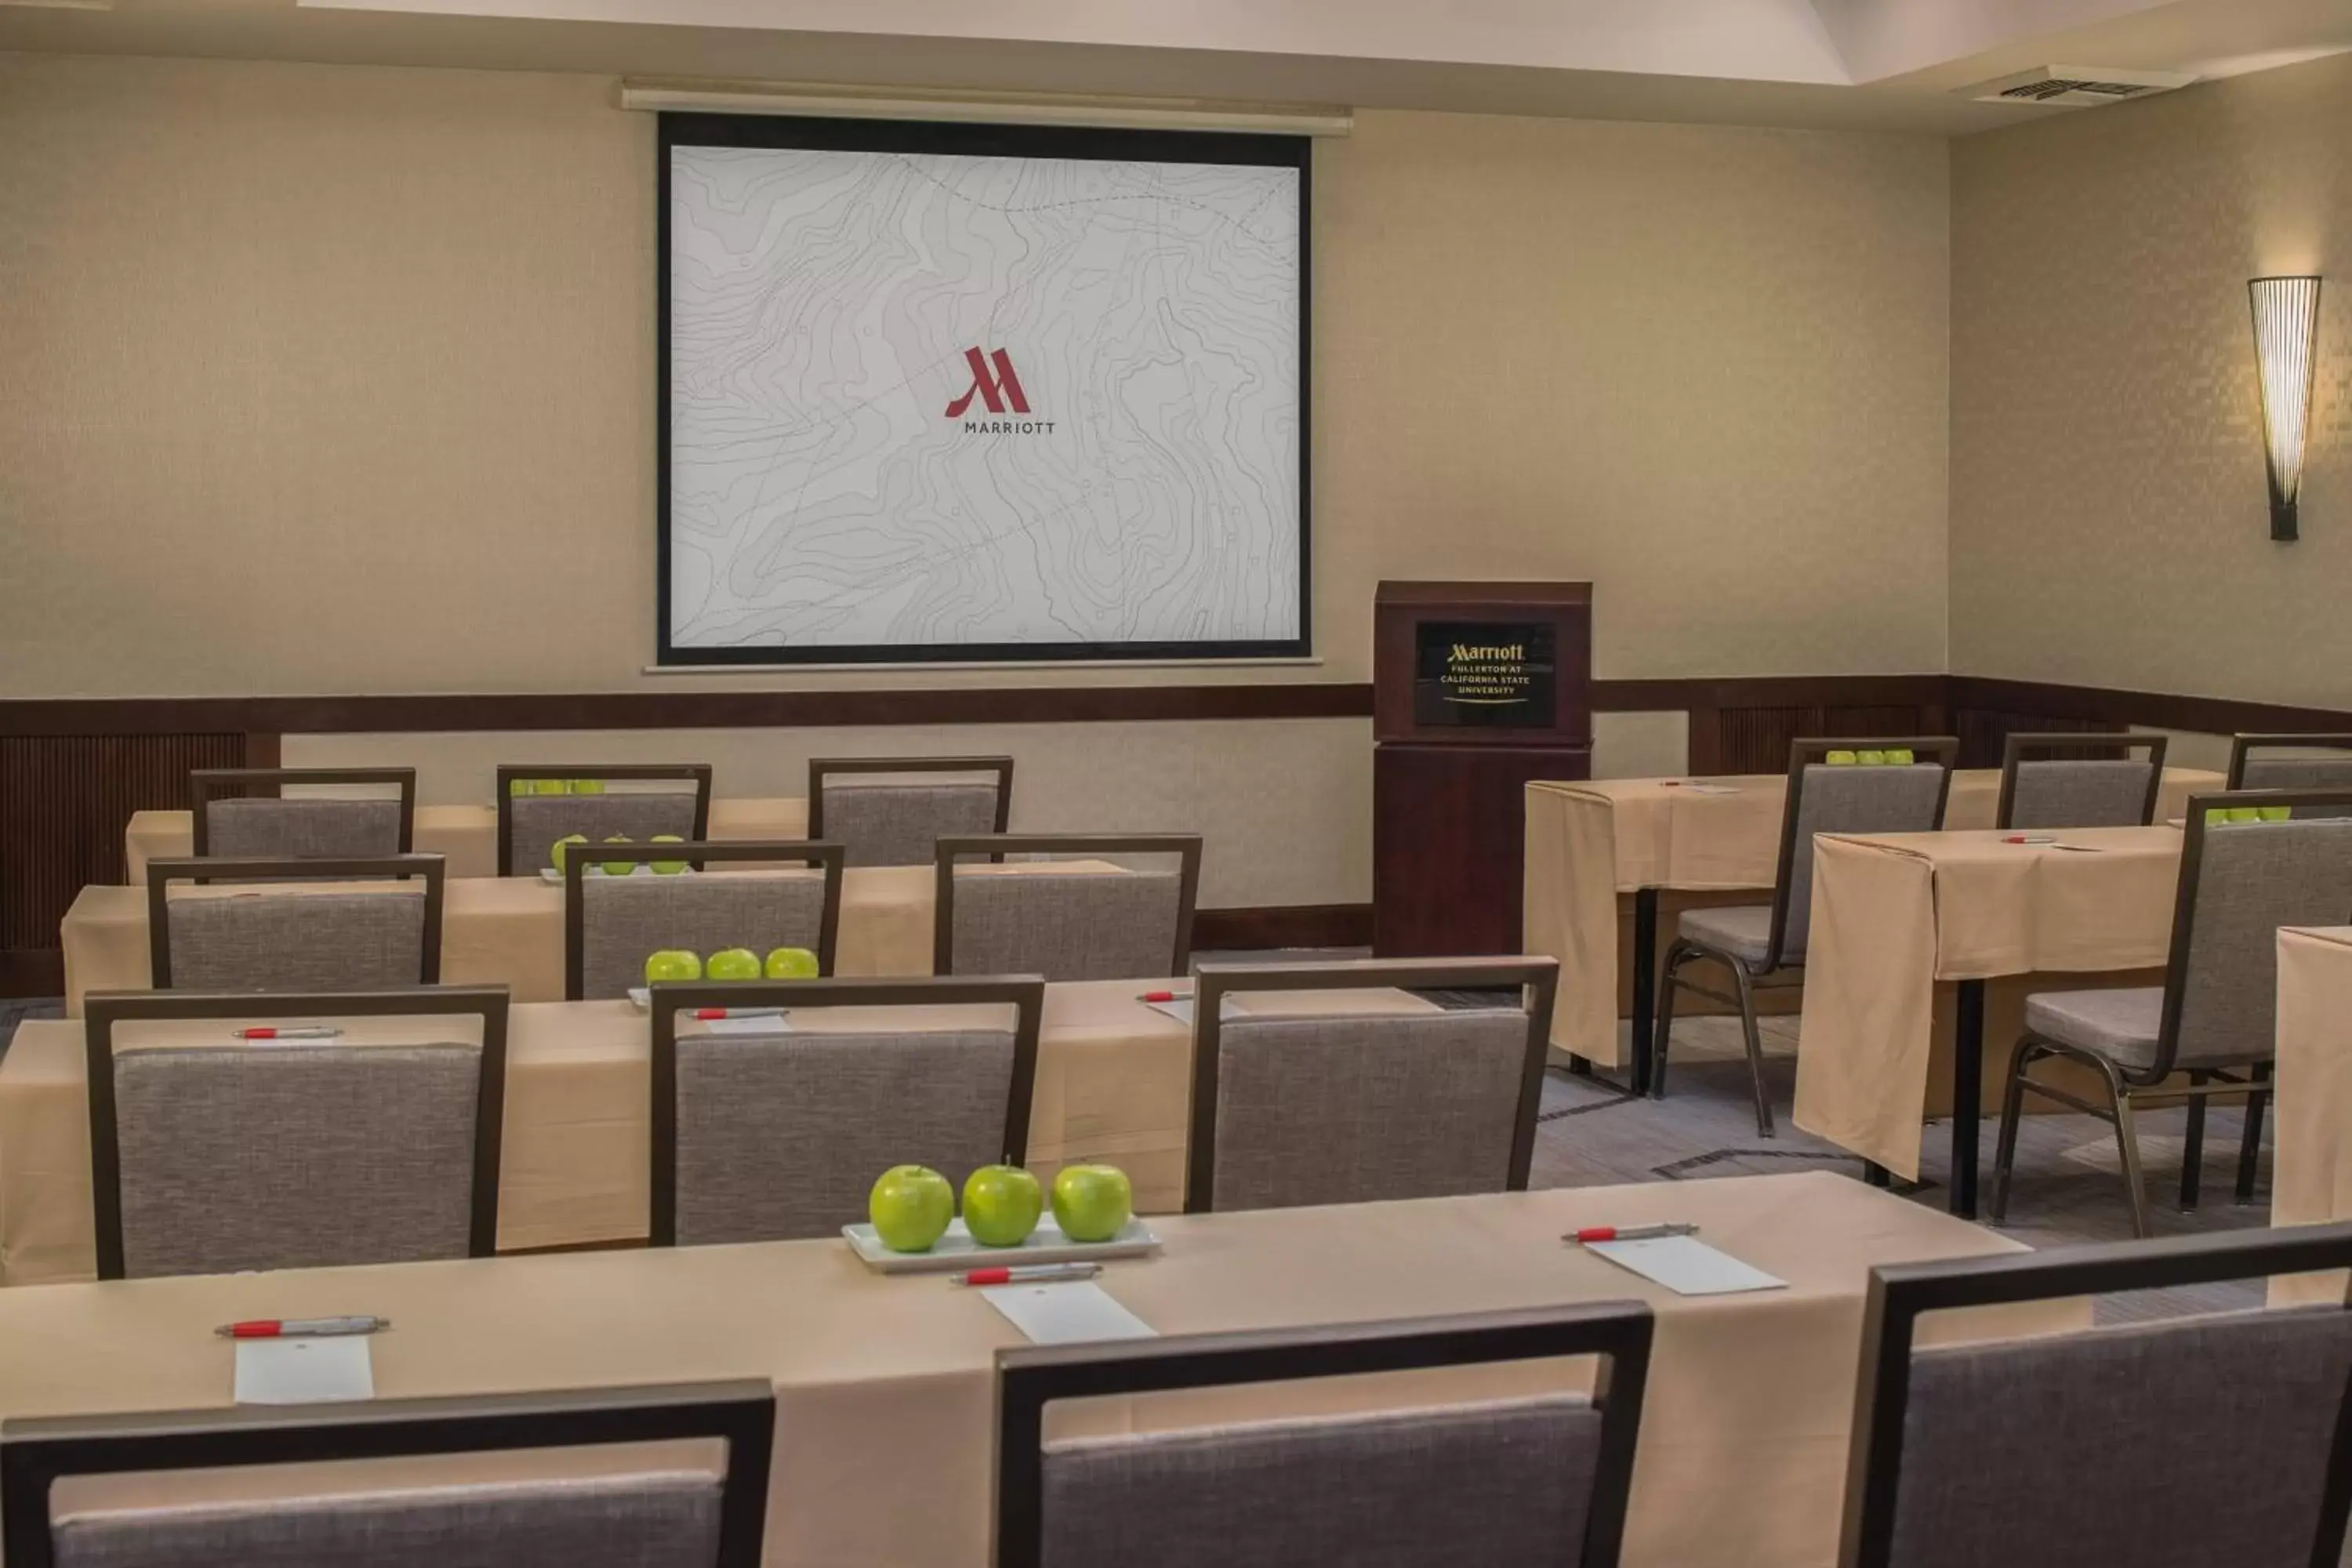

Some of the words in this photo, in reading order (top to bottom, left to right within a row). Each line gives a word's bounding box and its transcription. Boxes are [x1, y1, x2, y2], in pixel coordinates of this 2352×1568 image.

[965, 423, 1055, 434] MARRIOTT
[1447, 643, 1523, 662] Marriott
[1451, 665, 1506, 673] FULLERTON
[1510, 665, 1522, 673] AT
[1440, 675, 1498, 684] CALIFORNIA
[1501, 676, 1530, 684] STATE
